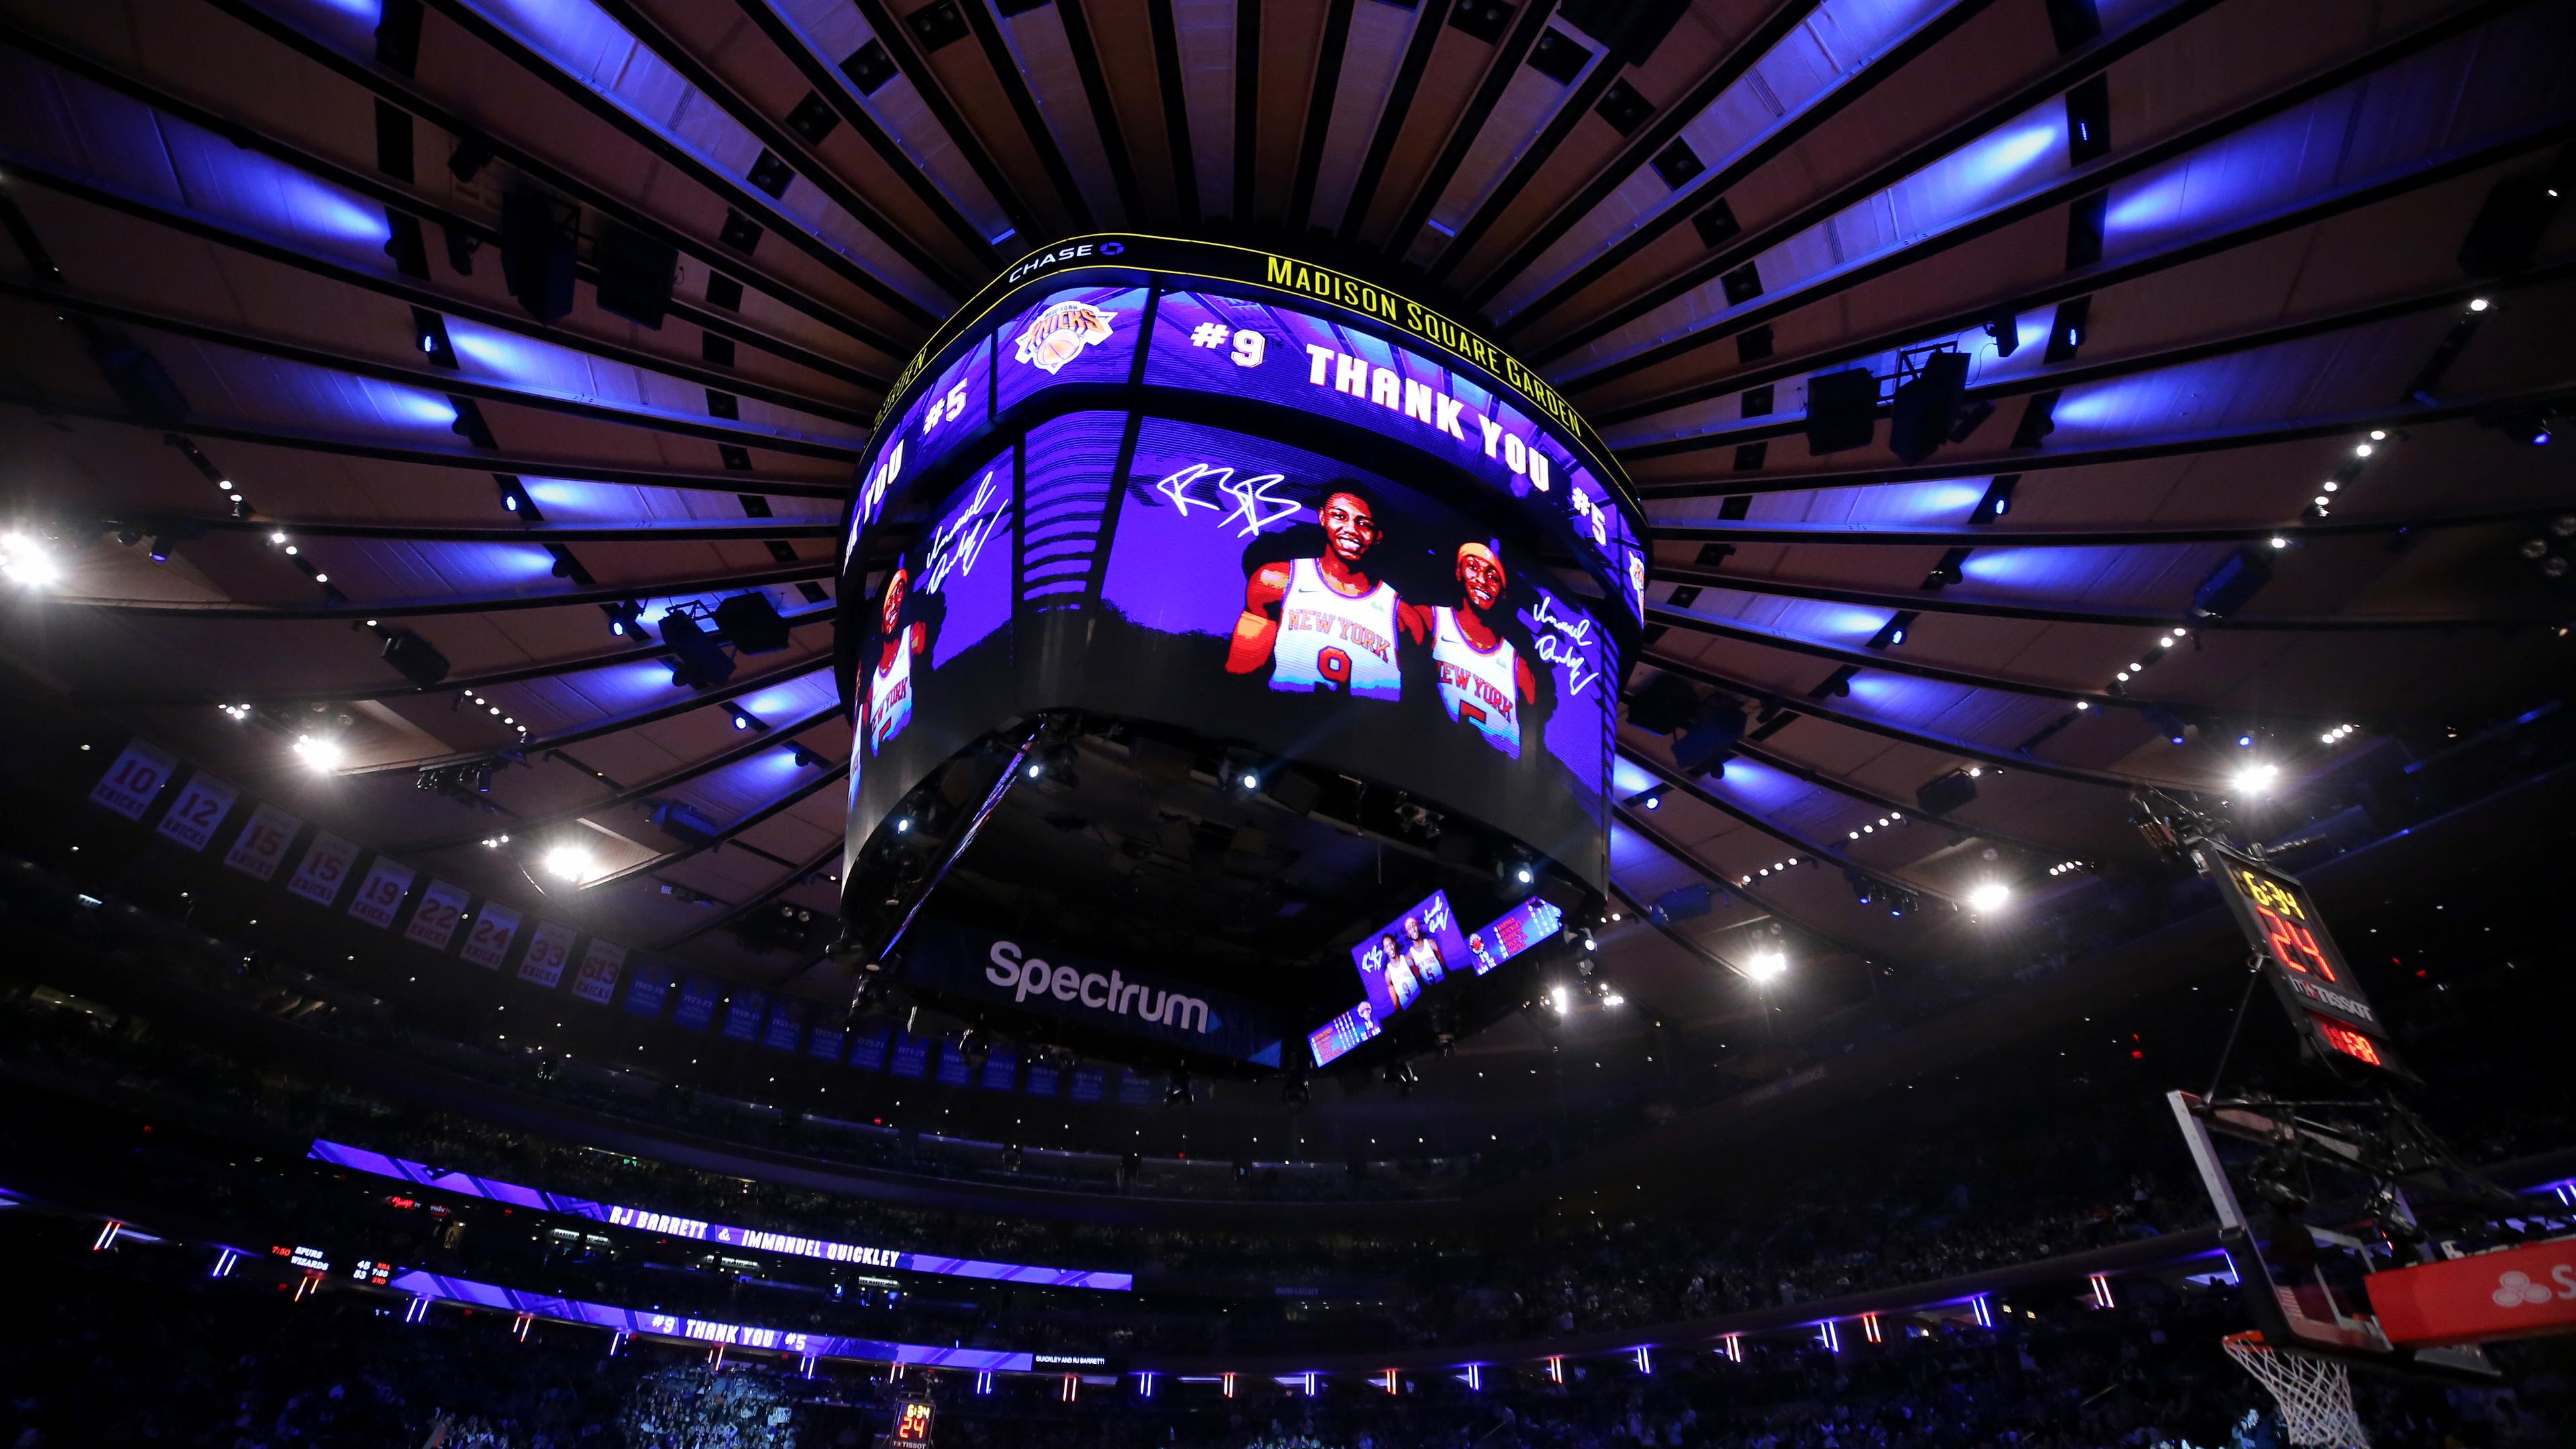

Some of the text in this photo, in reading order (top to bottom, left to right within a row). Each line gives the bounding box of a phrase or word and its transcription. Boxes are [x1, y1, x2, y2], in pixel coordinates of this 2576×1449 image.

[1009, 244, 1092, 283] CHASE
[1022, 309, 1106, 354] KNICKS
[1267, 256, 1581, 437] MADISON SQUARE GARDEN
[863, 439, 904, 525] YOU
[923, 377, 968, 436] #5
[1191, 321, 1607, 547] #9 THANK YOU #5
[1288, 609, 1391, 664] NEW YORK
[1473, 674, 1513, 724] YORK
[114, 759, 158, 794] 10
[179, 793, 219, 827] 12
[246, 824, 284, 856] 15
[307, 851, 345, 881] 15
[364, 876, 399, 906] 19
[2242, 870, 2306, 920] 6:34
[418, 898, 458, 929] 22
[474, 919, 511, 950] 24
[2256, 905, 2336, 982] 24
[530, 940, 565, 967] 33
[985, 941, 1210, 1034] Spectrum
[2310, 983, 2374, 1022] TISSOT
[294, 1246, 323, 1259] SPURS
[609, 1205, 900, 1268] RJ BARRETT & IMMANUEL QUICKLEY
[290, 1255, 329, 1271] WIZARDS
[376, 1263, 390, 1271] NBA
[372, 1277, 386, 1285] 2ND
[2552, 1265, 2576, 1299] S
[651, 1314, 808, 1351] #9 THANK YOU #5
[1035, 1355, 1061, 1363] QUICKLEY
[900, 1416, 925, 1439] 24
[906, 1403, 930, 1419] 6:34
[902, 1441, 926, 1449] TISSOT
